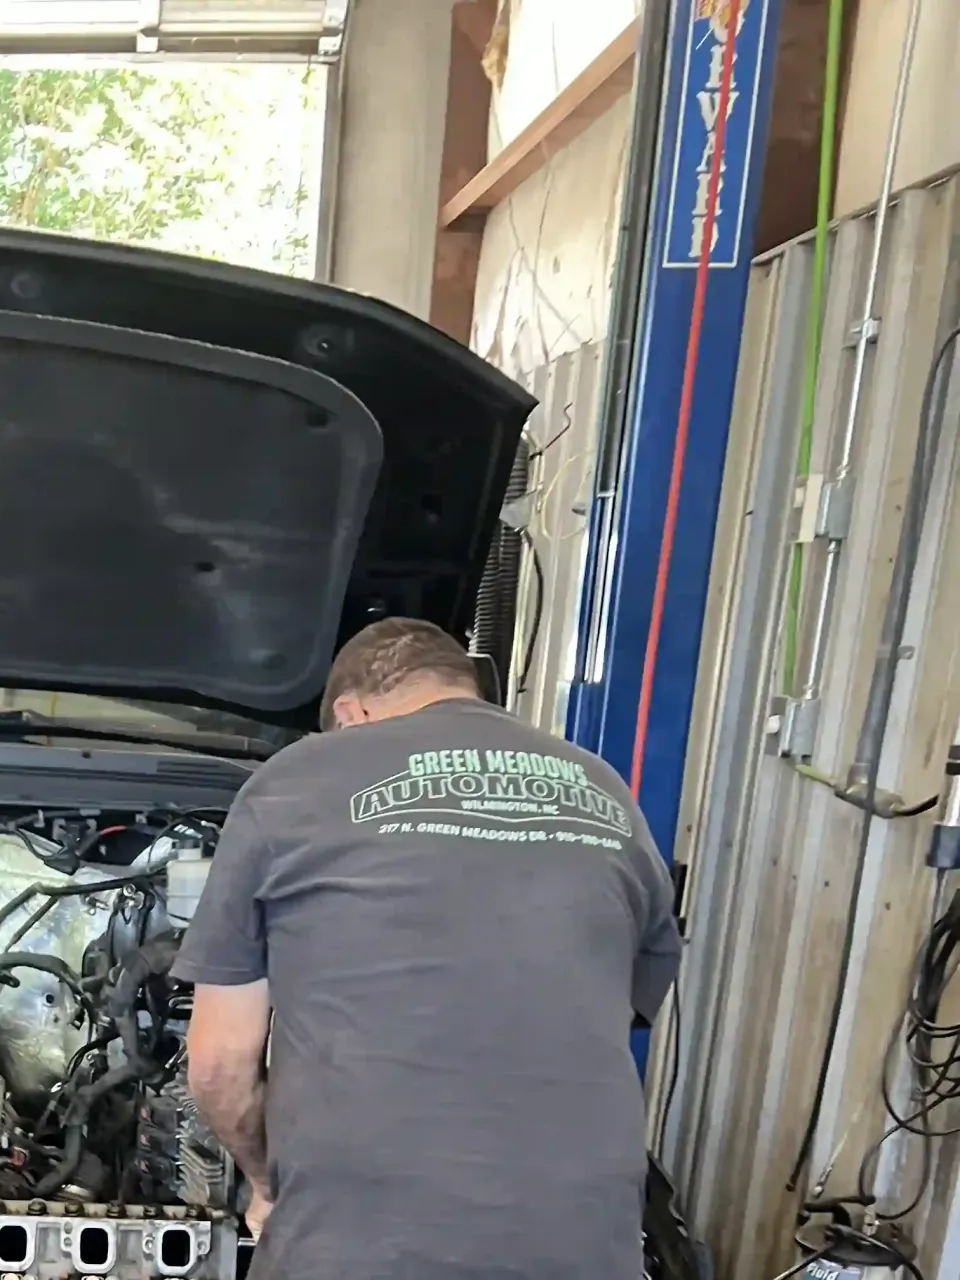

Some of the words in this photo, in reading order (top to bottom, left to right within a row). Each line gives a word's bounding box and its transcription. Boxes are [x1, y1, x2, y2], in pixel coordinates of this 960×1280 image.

[408, 750, 482, 777] GREEN
[485, 750, 588, 787] MEADOWS
[358, 773, 631, 832] AUTOMOTIVE
[400, 822, 415, 833] N.
[416, 822, 460, 836] GREEN
[461, 826, 527, 842] MEADOWS
